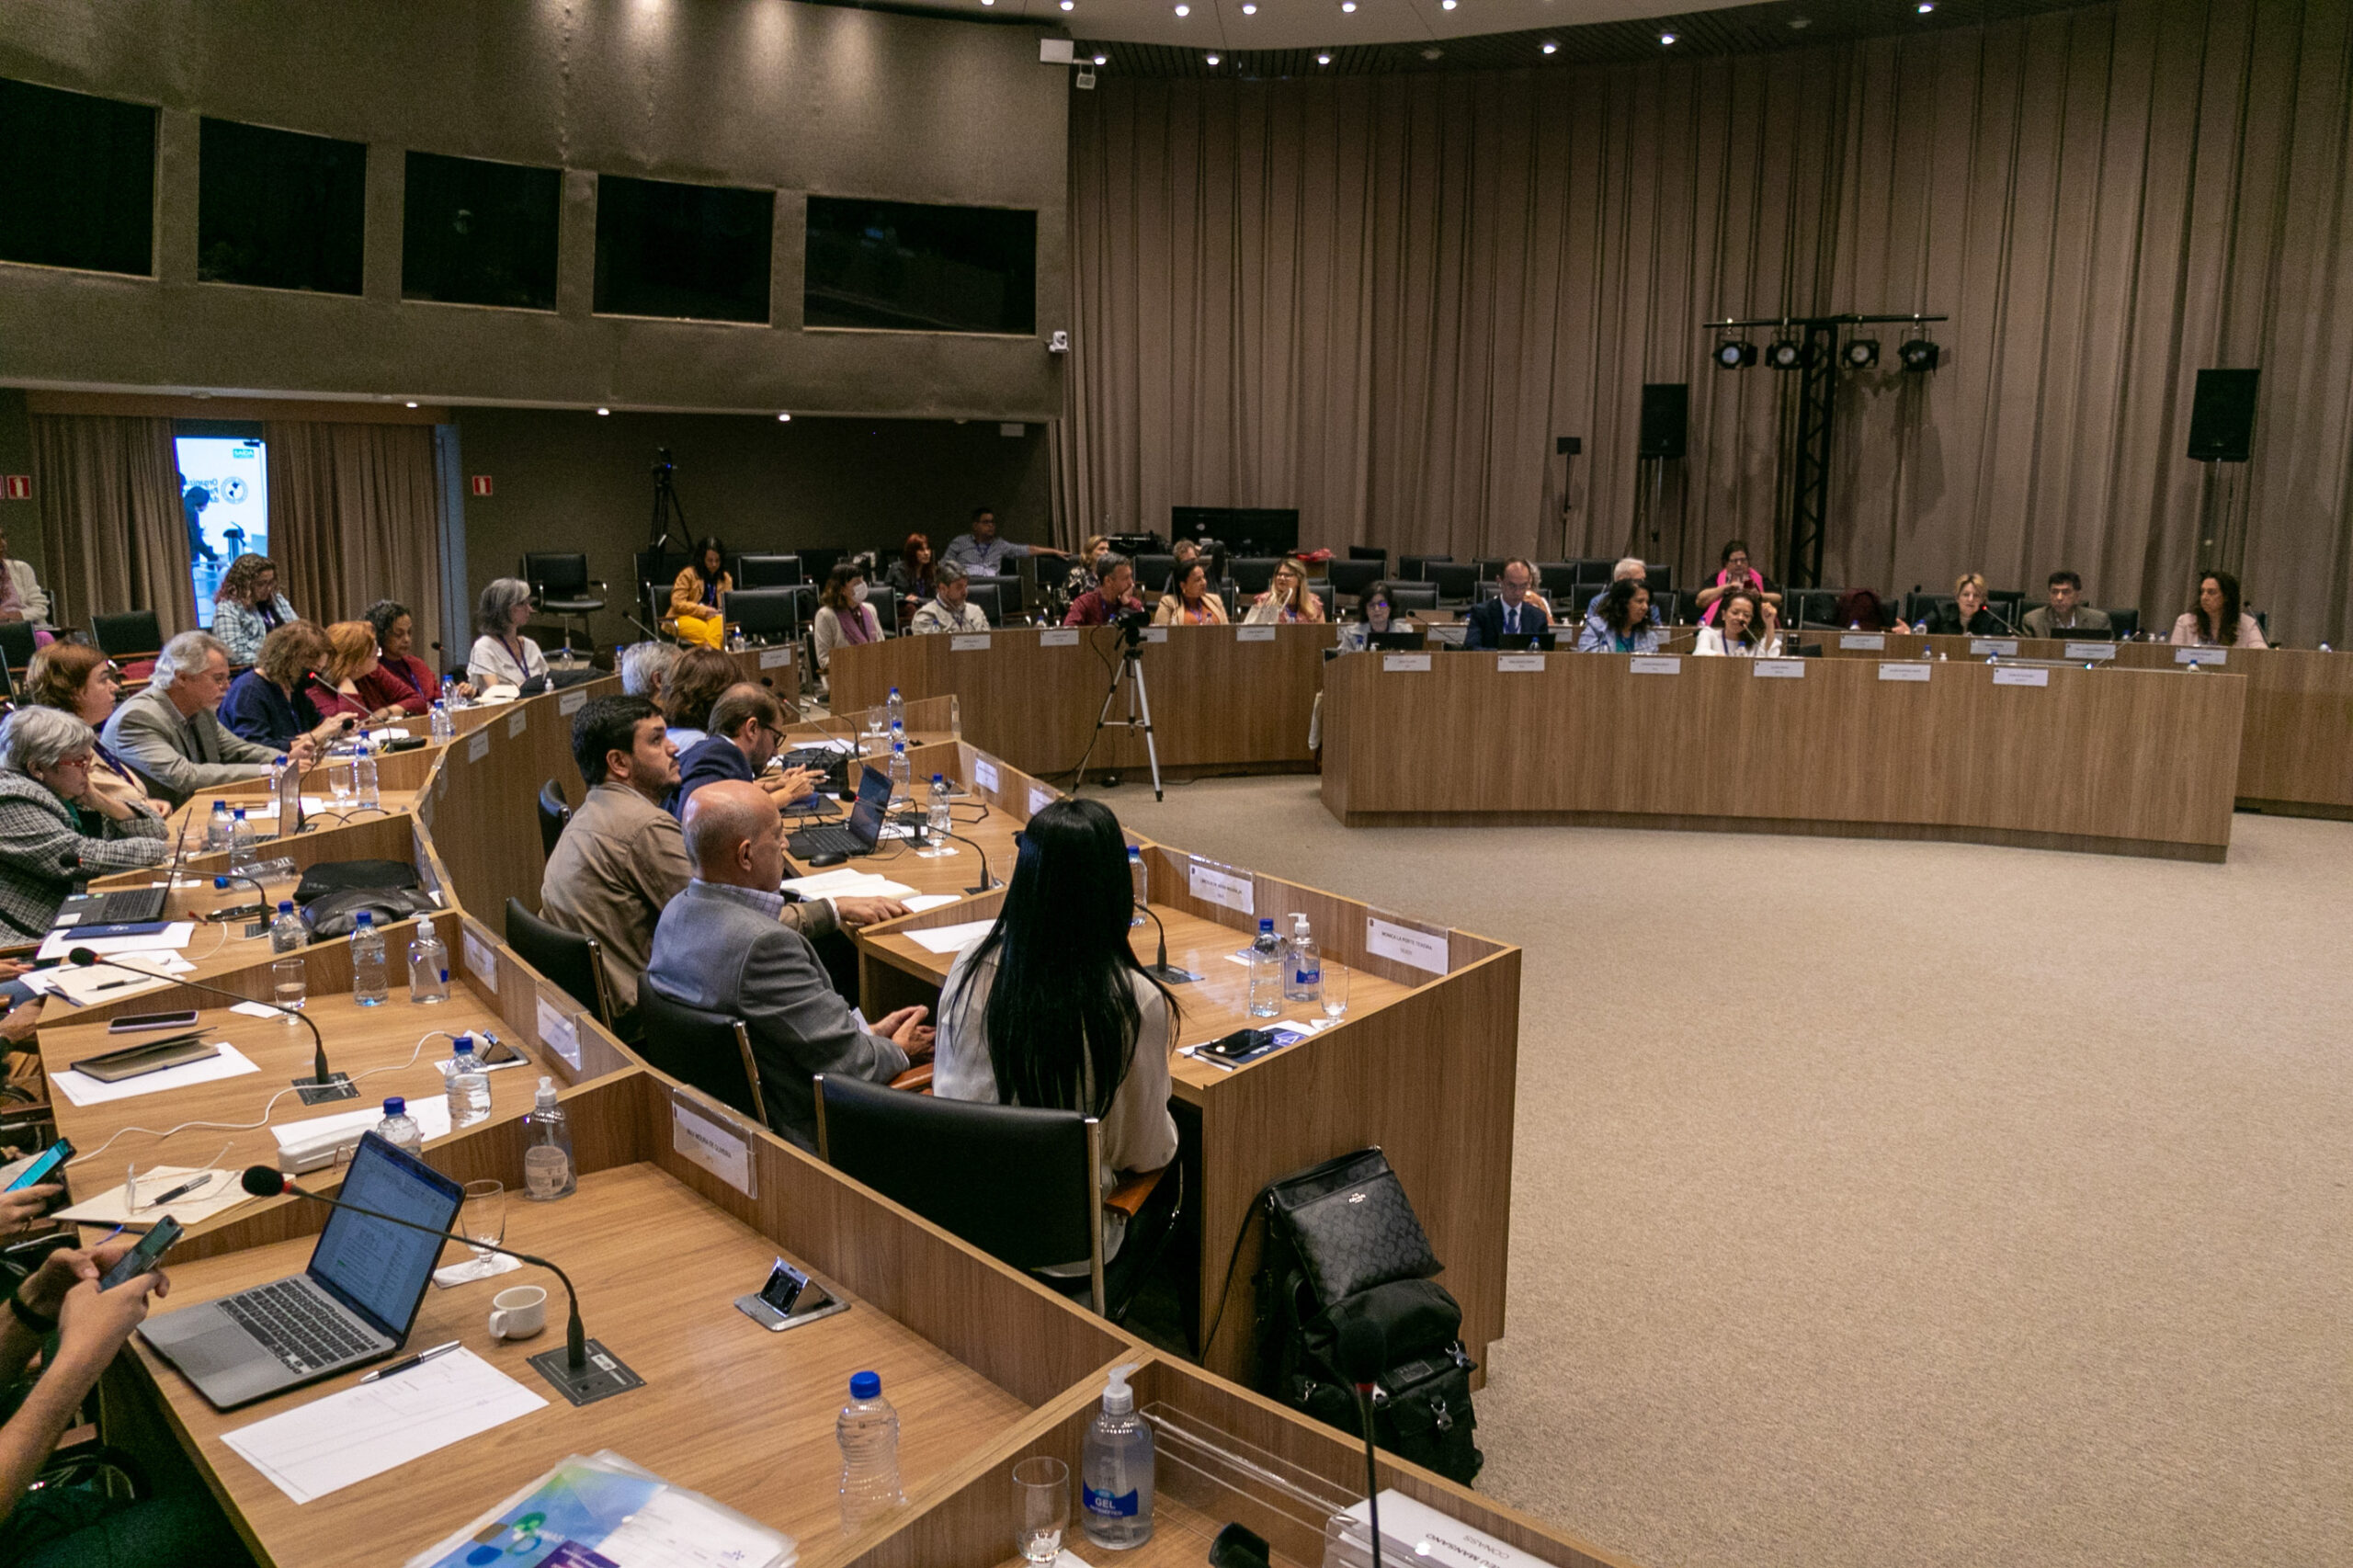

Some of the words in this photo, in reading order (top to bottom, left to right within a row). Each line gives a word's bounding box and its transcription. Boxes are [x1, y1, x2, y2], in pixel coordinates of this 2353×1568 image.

[1095, 1497, 1116, 1509] GEL
[1426, 1532, 1481, 1561] MANSANO
[1463, 1535, 1509, 1560] CONASS
